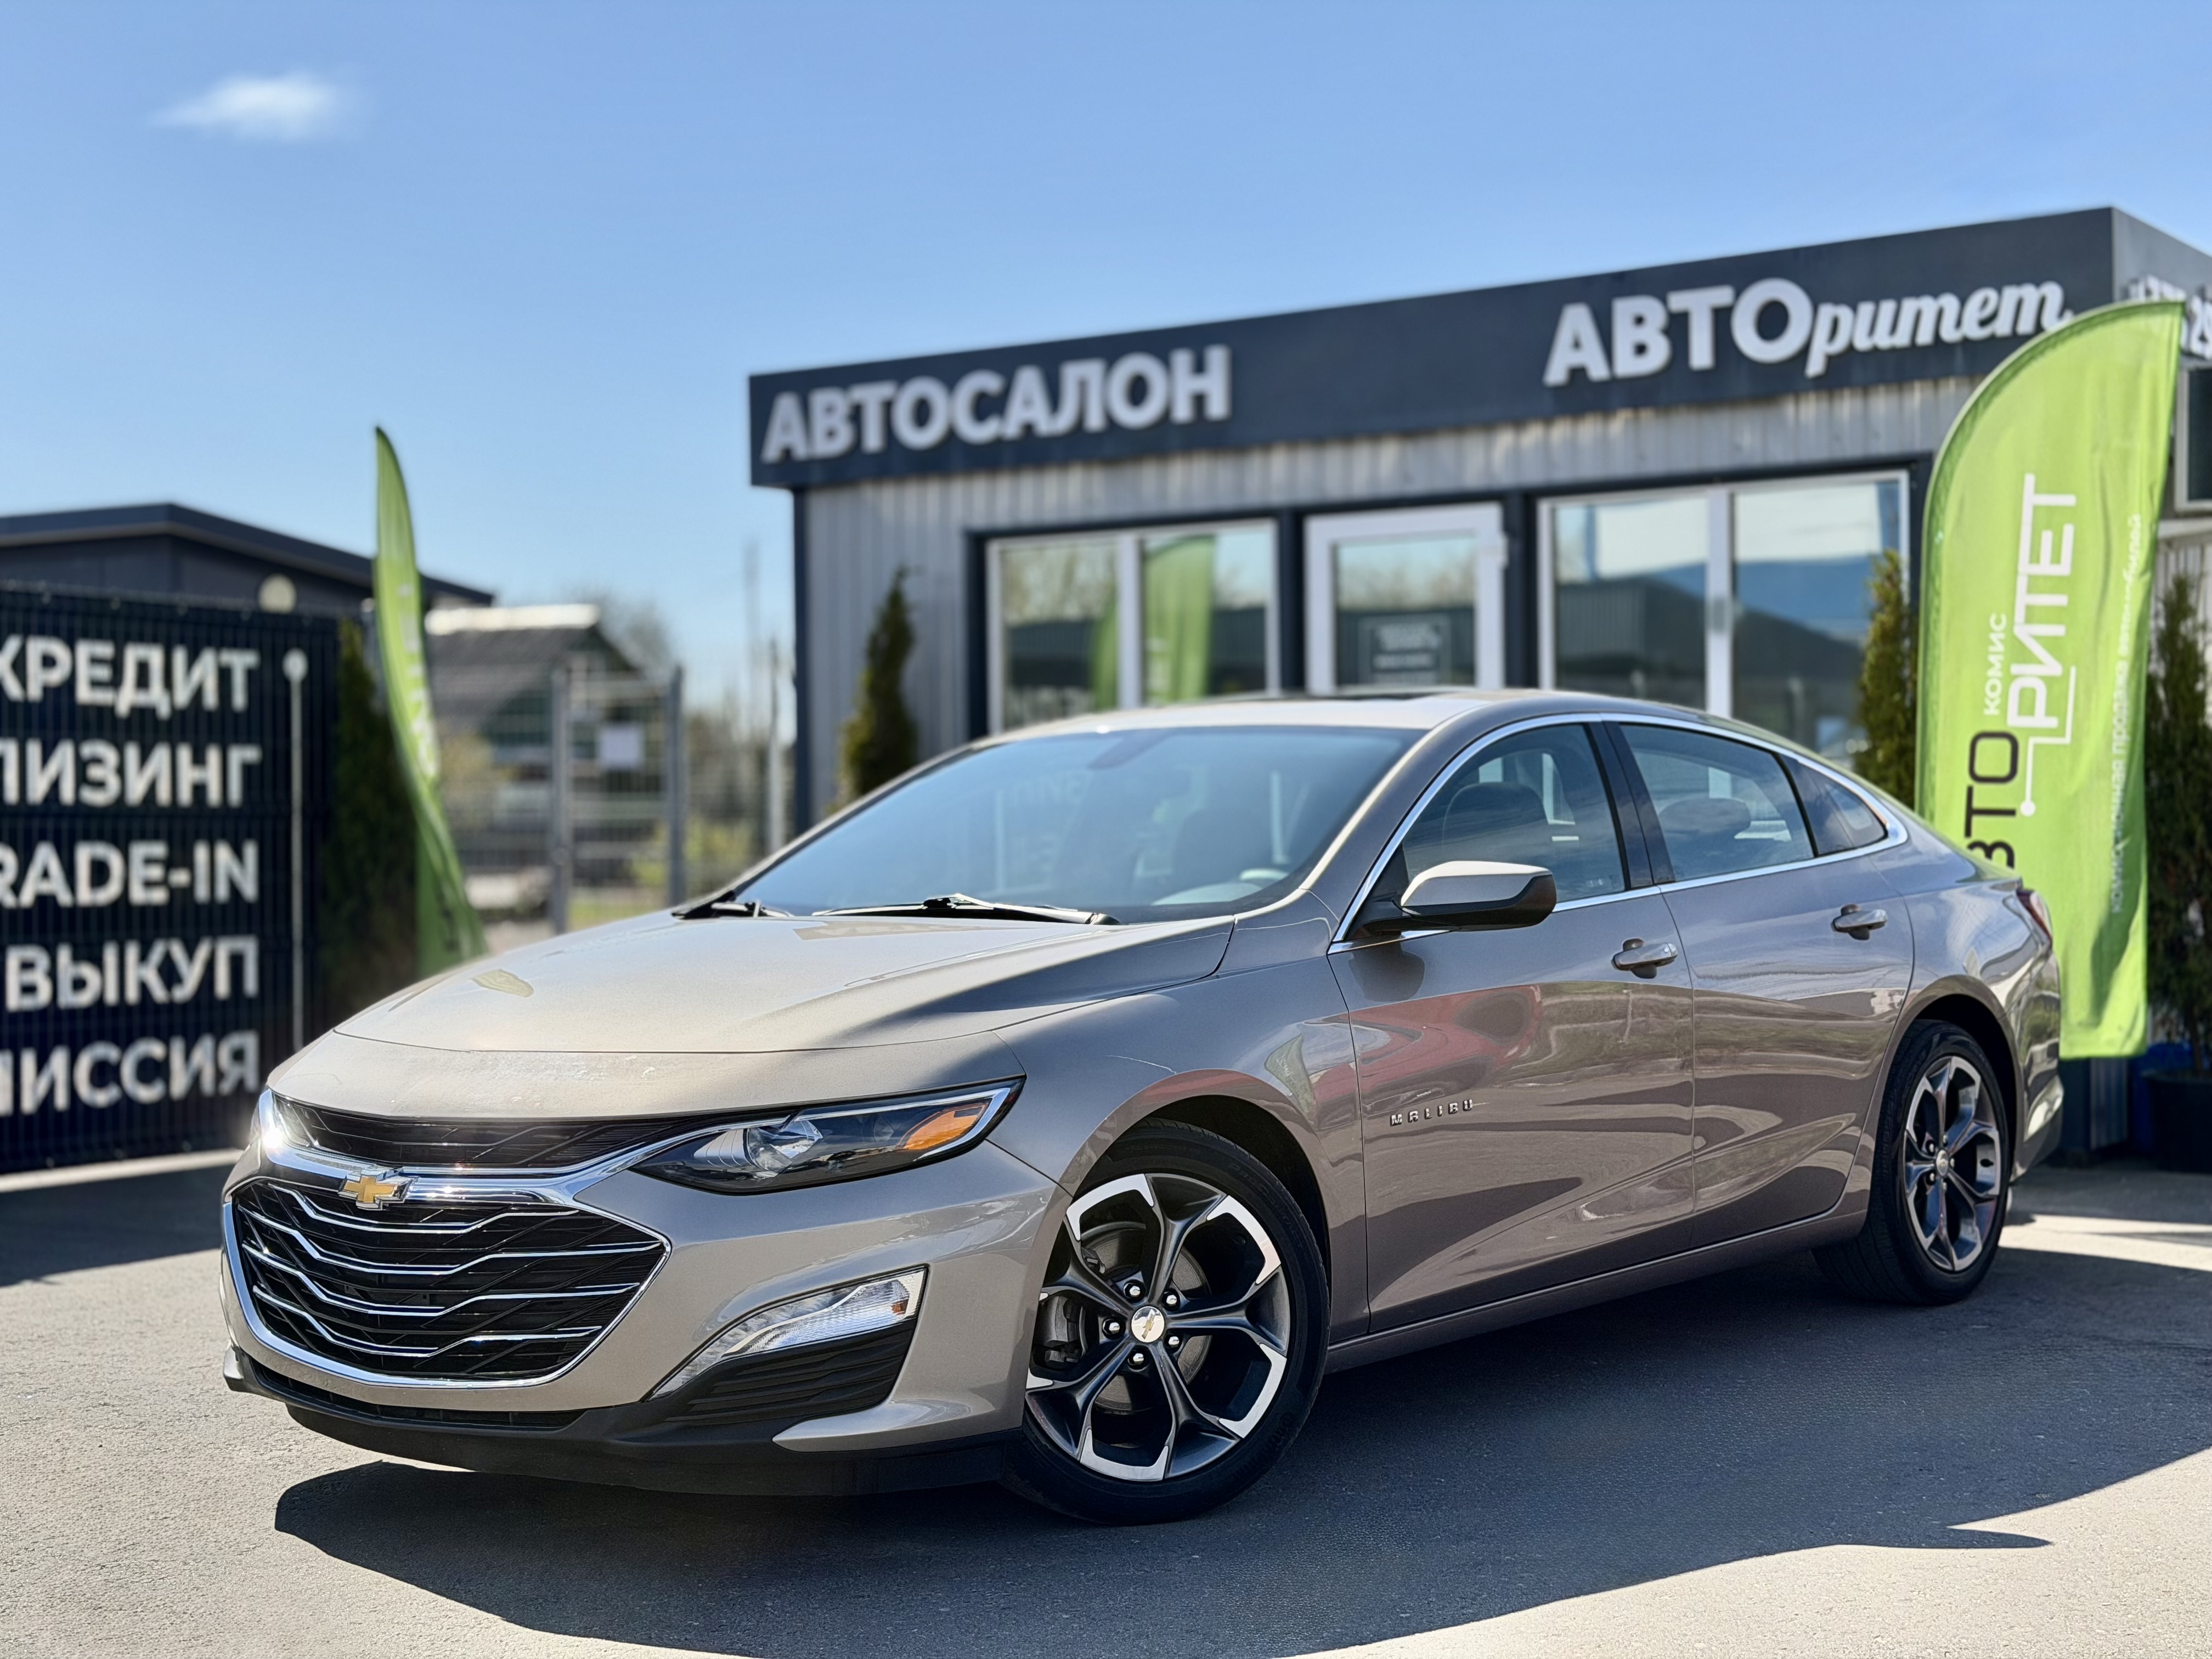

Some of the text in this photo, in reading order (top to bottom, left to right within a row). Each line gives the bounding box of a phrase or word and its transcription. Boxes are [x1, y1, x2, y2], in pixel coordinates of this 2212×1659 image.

[761, 343, 1232, 464] АВТОСАЛОН
[2006, 473, 2077, 729] РИТЕТ
[5, 935, 259, 1013] ВЫКУП
[0, 1030, 259, 1116] ИССИЯ
[1390, 1099, 1473, 1126] MALIBU
